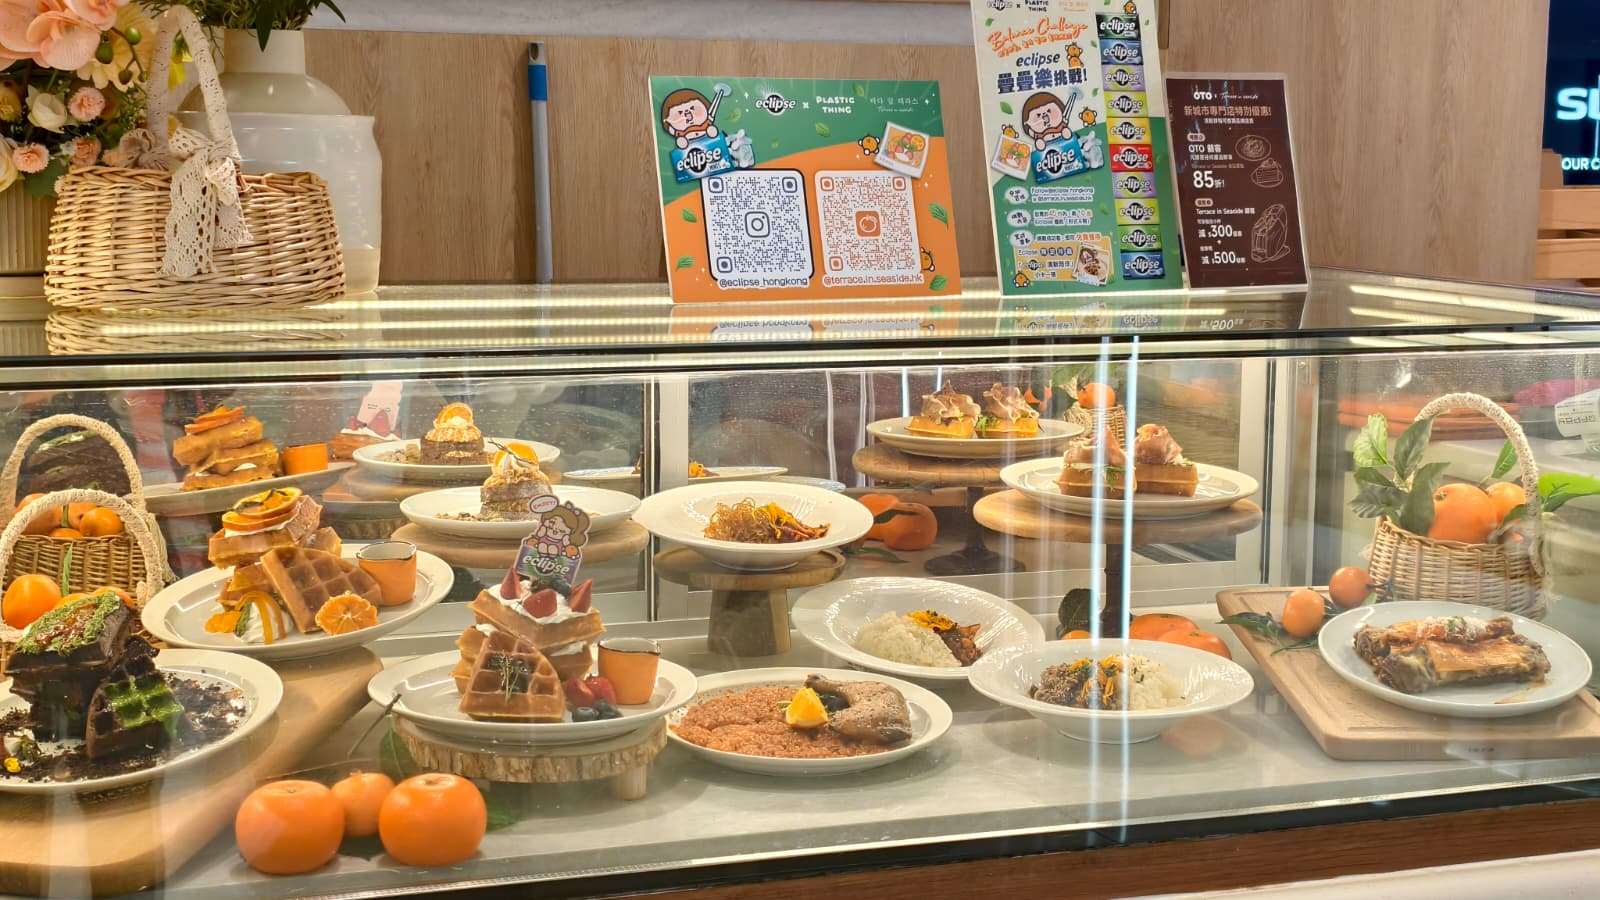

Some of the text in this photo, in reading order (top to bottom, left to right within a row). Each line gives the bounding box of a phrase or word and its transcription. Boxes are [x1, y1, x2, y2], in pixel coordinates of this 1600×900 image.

[1100, 17, 1136, 33] eclipse
[1104, 44, 1138, 60] eclipse
[1016, 53, 1060, 68] eclipse
[1106, 69, 1140, 84] eclipse
[816, 96, 855, 104] PLASTIC
[1194, 92, 1212, 100] OTO
[756, 97, 796, 112] eclipse
[1108, 96, 1143, 112] eclipse
[1110, 124, 1146, 138] eclipse
[1188, 144, 1204, 152] OTO
[677, 148, 721, 171] eclipse
[1036, 149, 1074, 172] eclipse
[1113, 150, 1148, 164] eclipse
[1562, 157, 1588, 170] OUR
[1117, 178, 1150, 192] eclipse
[1120, 204, 1154, 218] eclipse
[1122, 232, 1156, 246] eclipse
[1124, 258, 1160, 272] eclipse
[719, 278, 808, 288] @eclipse_hongkong
[824, 275, 923, 285] @terrace.in.seaside.hk
[522, 554, 570, 575] eclipse
